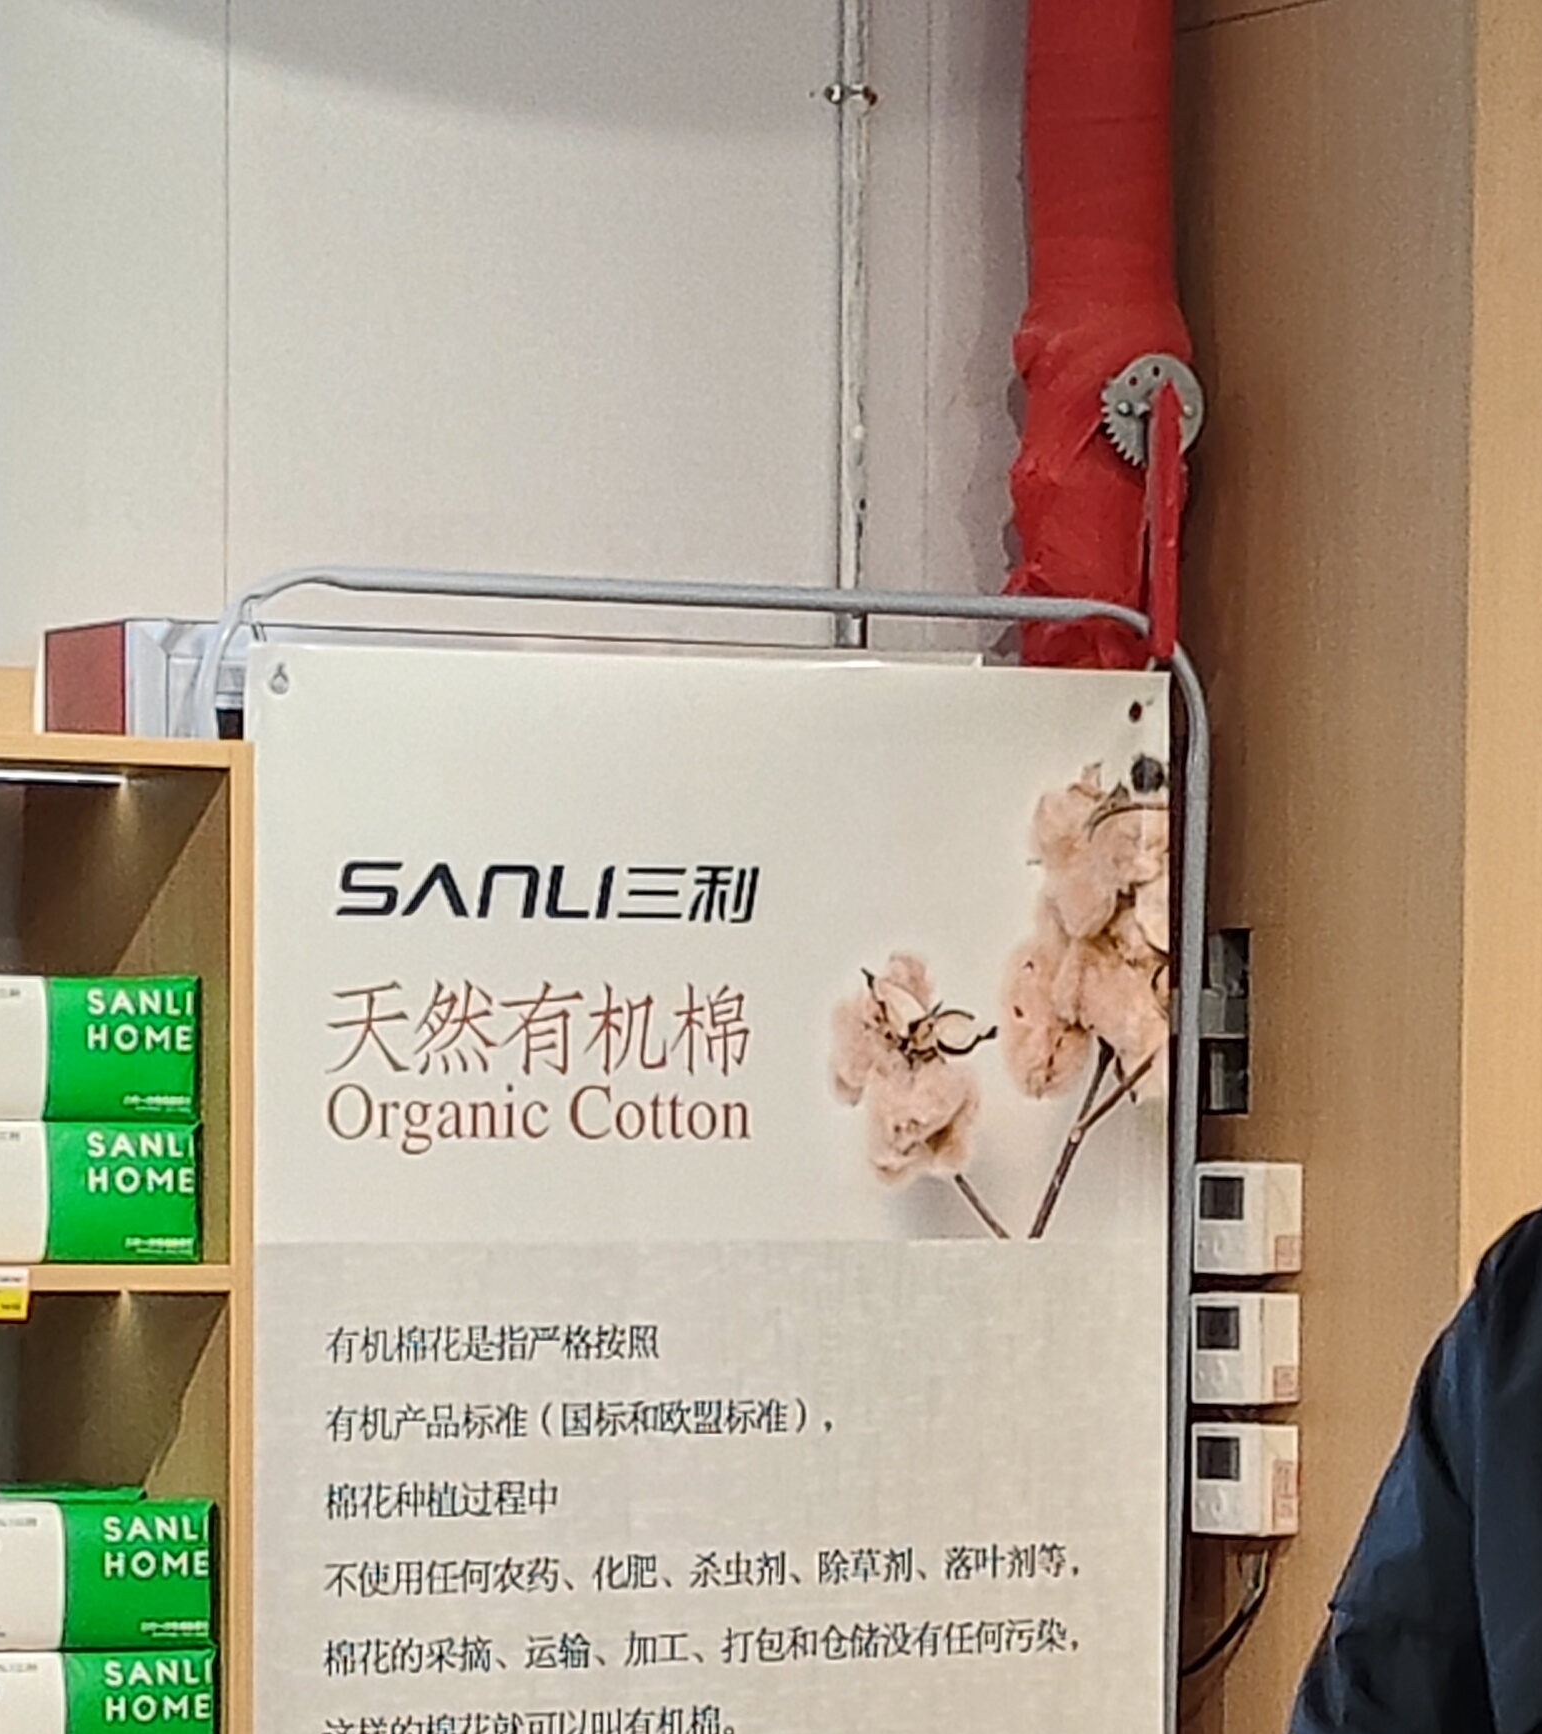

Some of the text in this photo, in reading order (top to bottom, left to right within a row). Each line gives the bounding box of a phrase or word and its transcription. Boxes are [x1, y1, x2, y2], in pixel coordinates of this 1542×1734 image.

[86, 989, 195, 1016] SANLI
[86, 1024, 194, 1052] HOME
[324, 978, 753, 1078] 天然有机棉
[326, 1079, 752, 1155] Organic Cotton
[86, 1130, 196, 1158] SANLI
[86, 1166, 195, 1194] HOME
[325, 1322, 661, 1365] 有机棉花是指严格按照
[325, 1397, 837, 1442] 有机产品标准（国标和欧盟标准），
[325, 1480, 560, 1521] 棉花种植过程中
[103, 1515, 209, 1542] SANLI
[104, 1550, 209, 1578] HOME
[323, 1540, 1081, 1597] 不使用任何农药、化肥、杀虫剂、除草剂、落叶剂等，
[322, 1616, 1081, 1676] 棉花的采摘、运输、加工、打包和仓储没有任何污染，
[104, 1660, 212, 1687] SANLI
[106, 1697, 211, 1723] HOME
